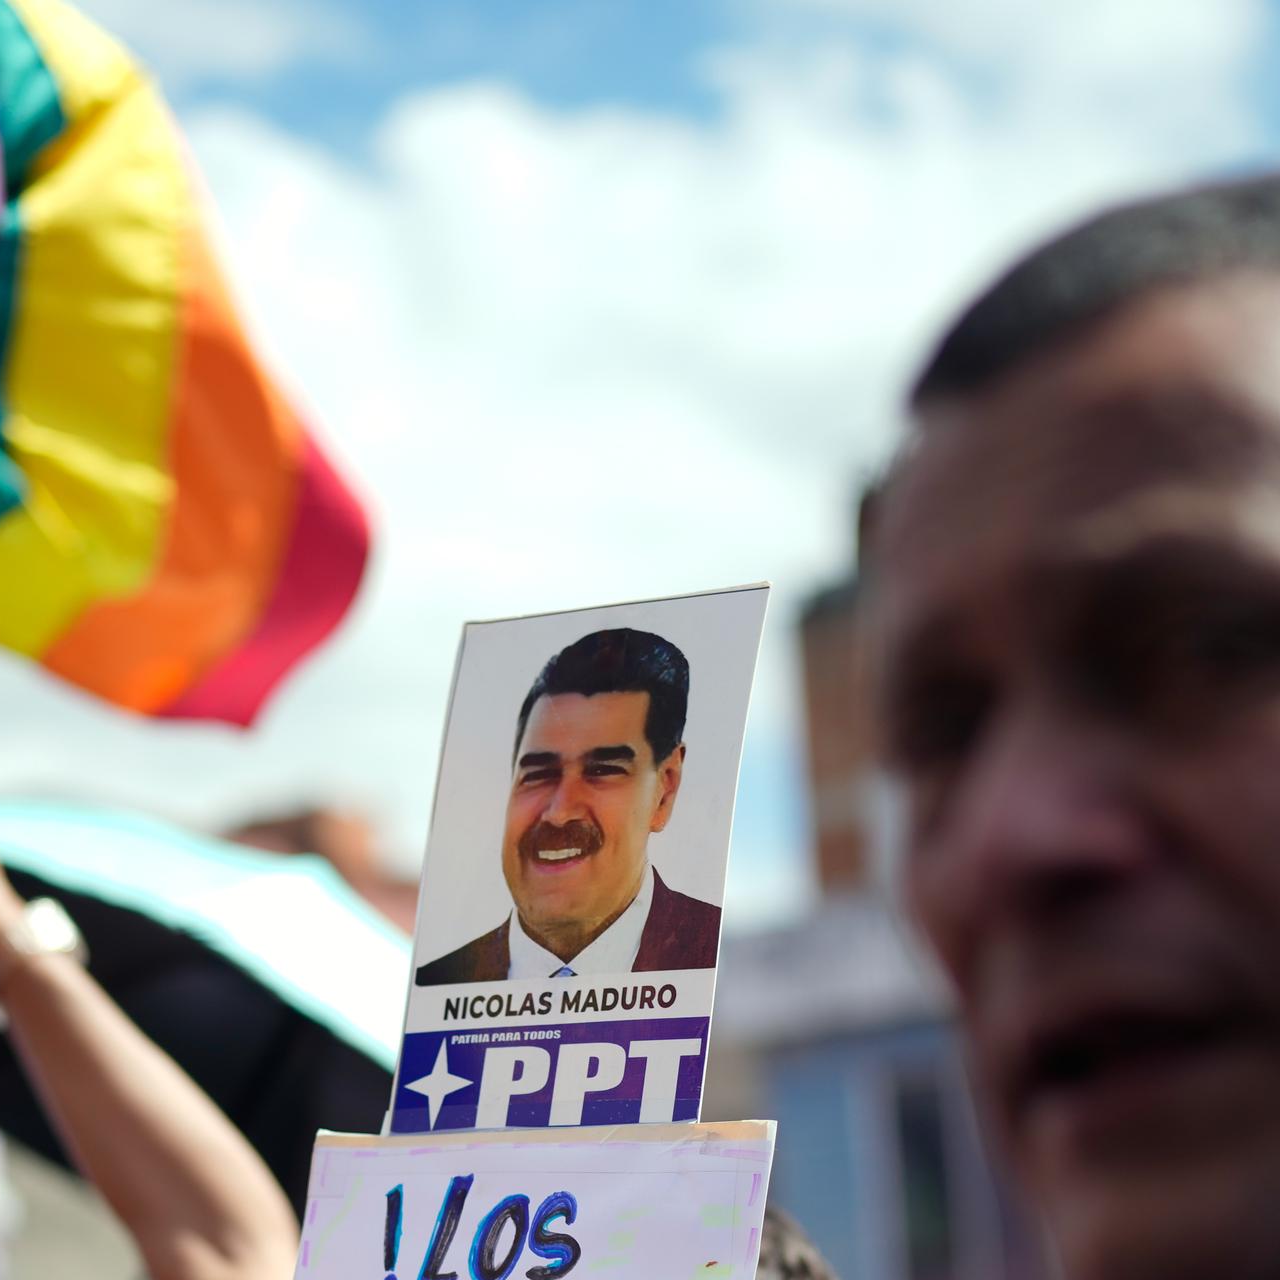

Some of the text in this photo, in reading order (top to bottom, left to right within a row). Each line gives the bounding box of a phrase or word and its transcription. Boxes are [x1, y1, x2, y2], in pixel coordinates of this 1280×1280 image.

[443, 983, 677, 1021] NICOLAS MADURO
[451, 1029, 562, 1046] PATRIA PARA TODOS
[474, 1037, 703, 1129] PPT
